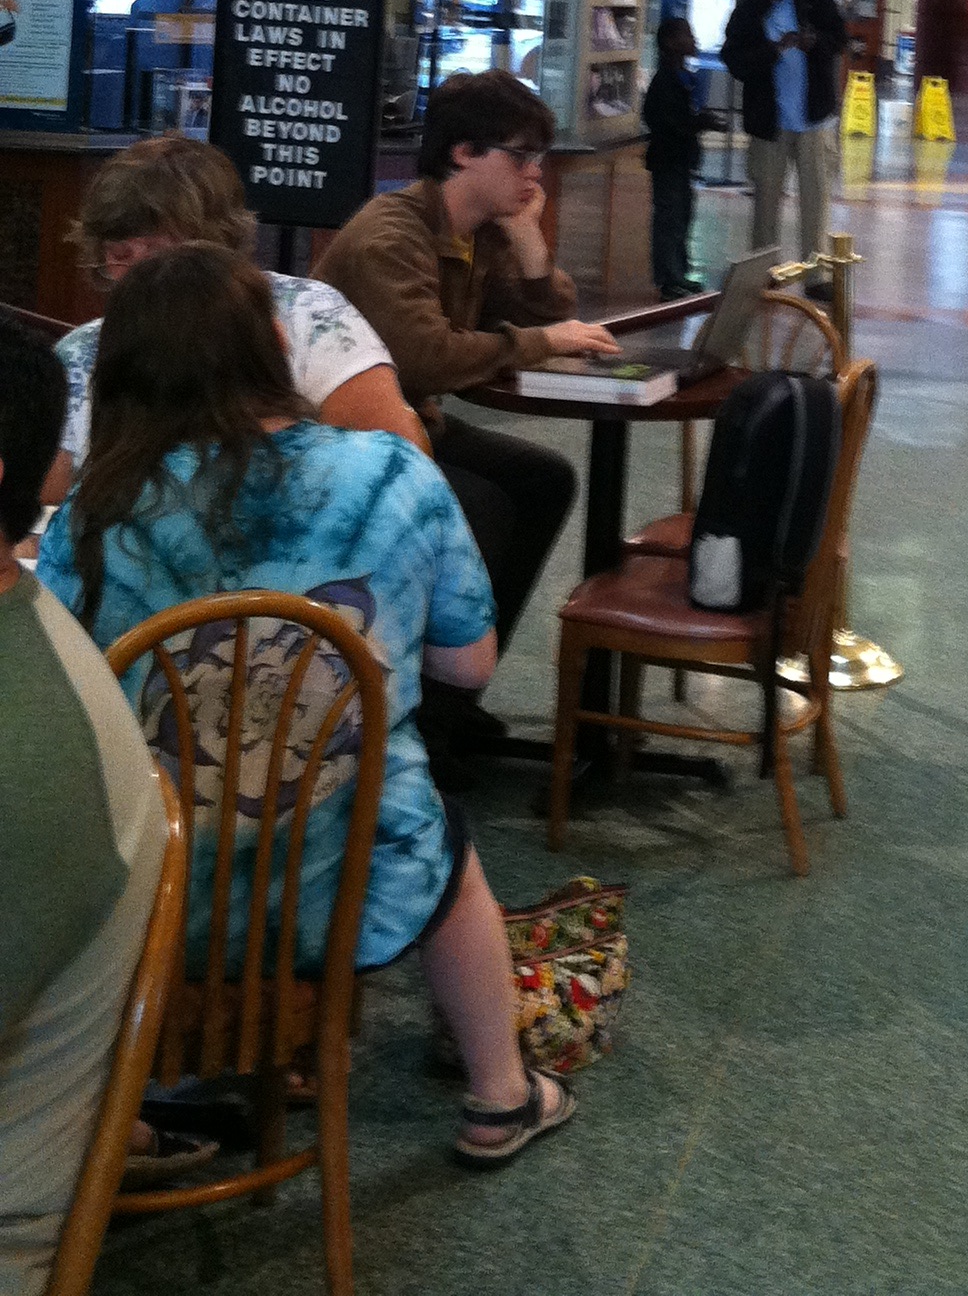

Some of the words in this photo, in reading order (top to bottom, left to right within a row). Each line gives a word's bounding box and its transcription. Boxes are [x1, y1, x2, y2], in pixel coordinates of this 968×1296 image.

[231, 0, 369, 27] CONTAINER
[234, 23, 303, 46] LAWS
[317, 29, 346, 49] IN
[247, 47, 336, 72] EFFECT
[275, 74, 311, 94] NO
[238, 94, 349, 120] ALCOHOL
[244, 118, 341, 143] BEYOND
[260, 143, 320, 165] THIS
[250, 165, 327, 189] POINT
